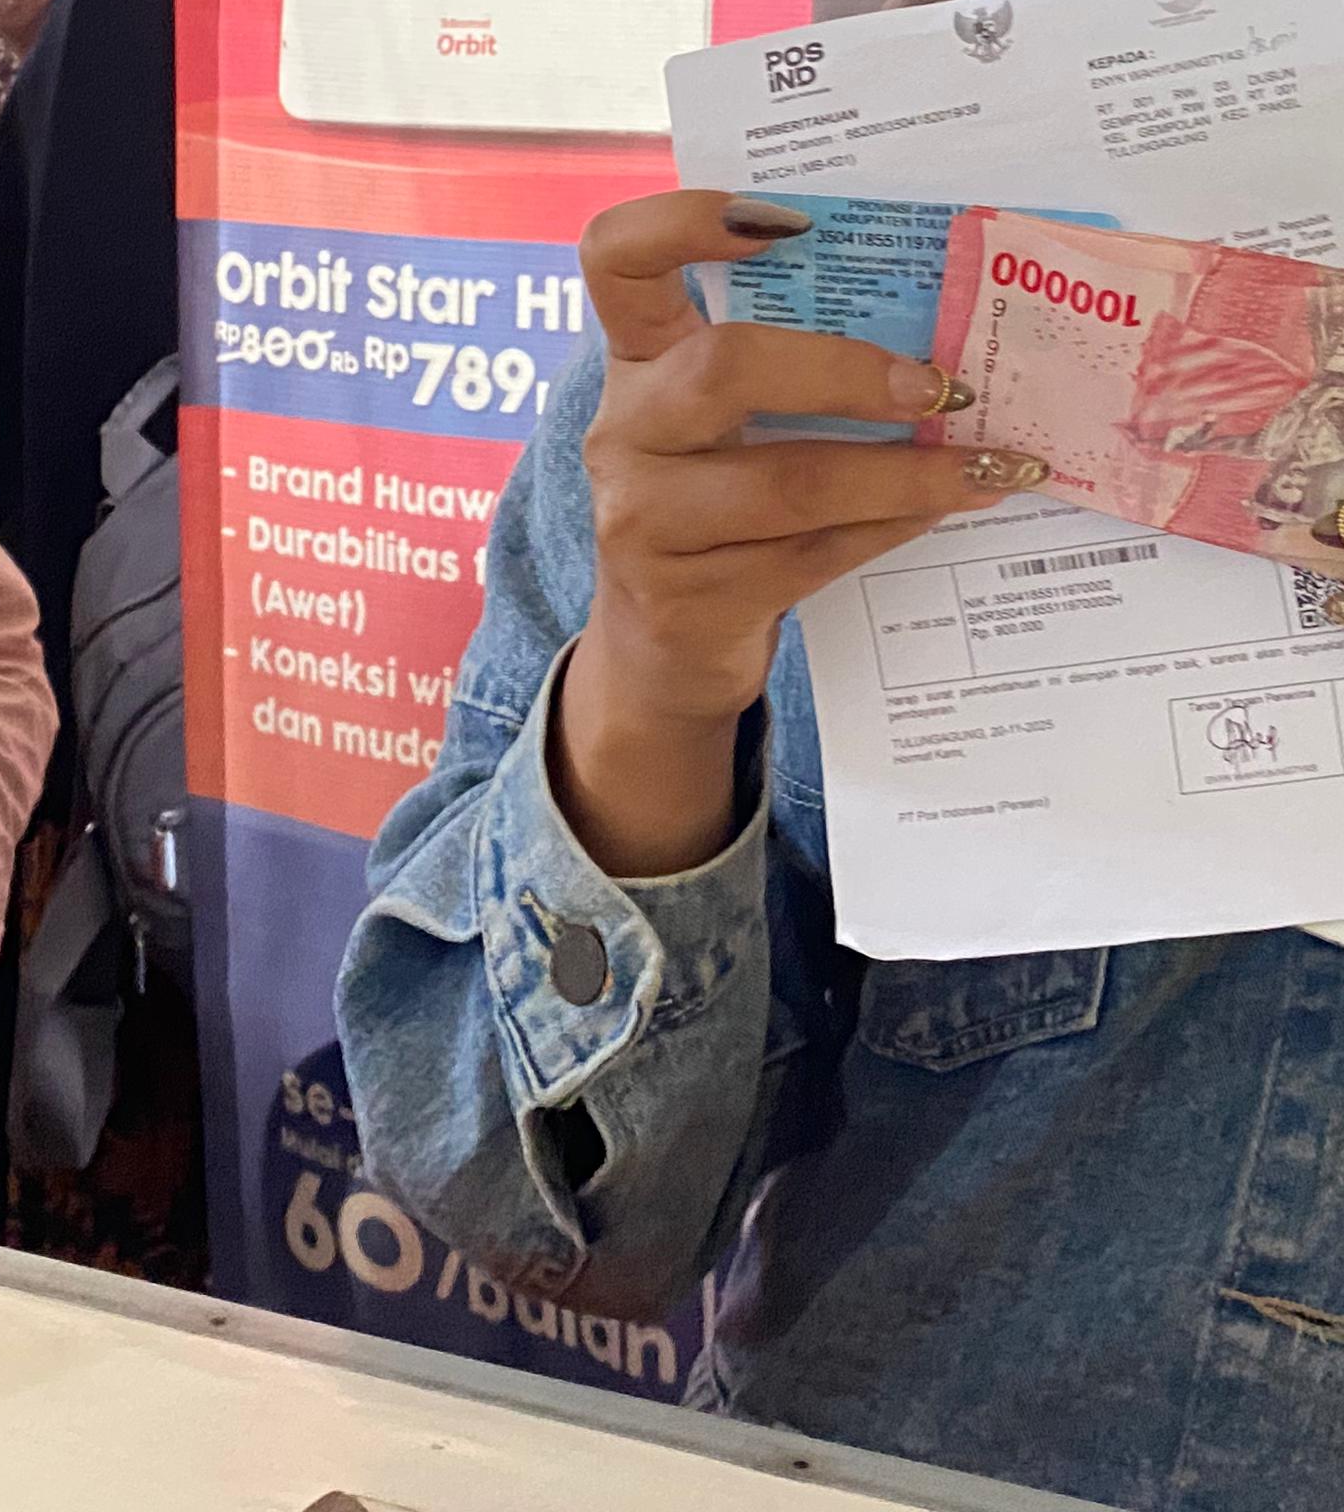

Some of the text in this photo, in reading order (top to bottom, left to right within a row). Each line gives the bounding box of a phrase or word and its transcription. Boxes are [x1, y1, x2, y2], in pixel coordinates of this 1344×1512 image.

[436, 33, 498, 57] Orbit
[764, 41, 825, 71] POS
[1087, 49, 1147, 71] KEPADA
[745, 107, 860, 141] PEMBERITAHUAN
[215, 248, 354, 315] Orbit
[365, 263, 497, 327] Star
[990, 251, 1142, 328] 100000
[247, 454, 364, 507] Brand
[247, 514, 462, 584] Durabilitas
[250, 571, 367, 636] (Awet)
[249, 635, 397, 699] Koneksi
[251, 695, 324, 747] dan
